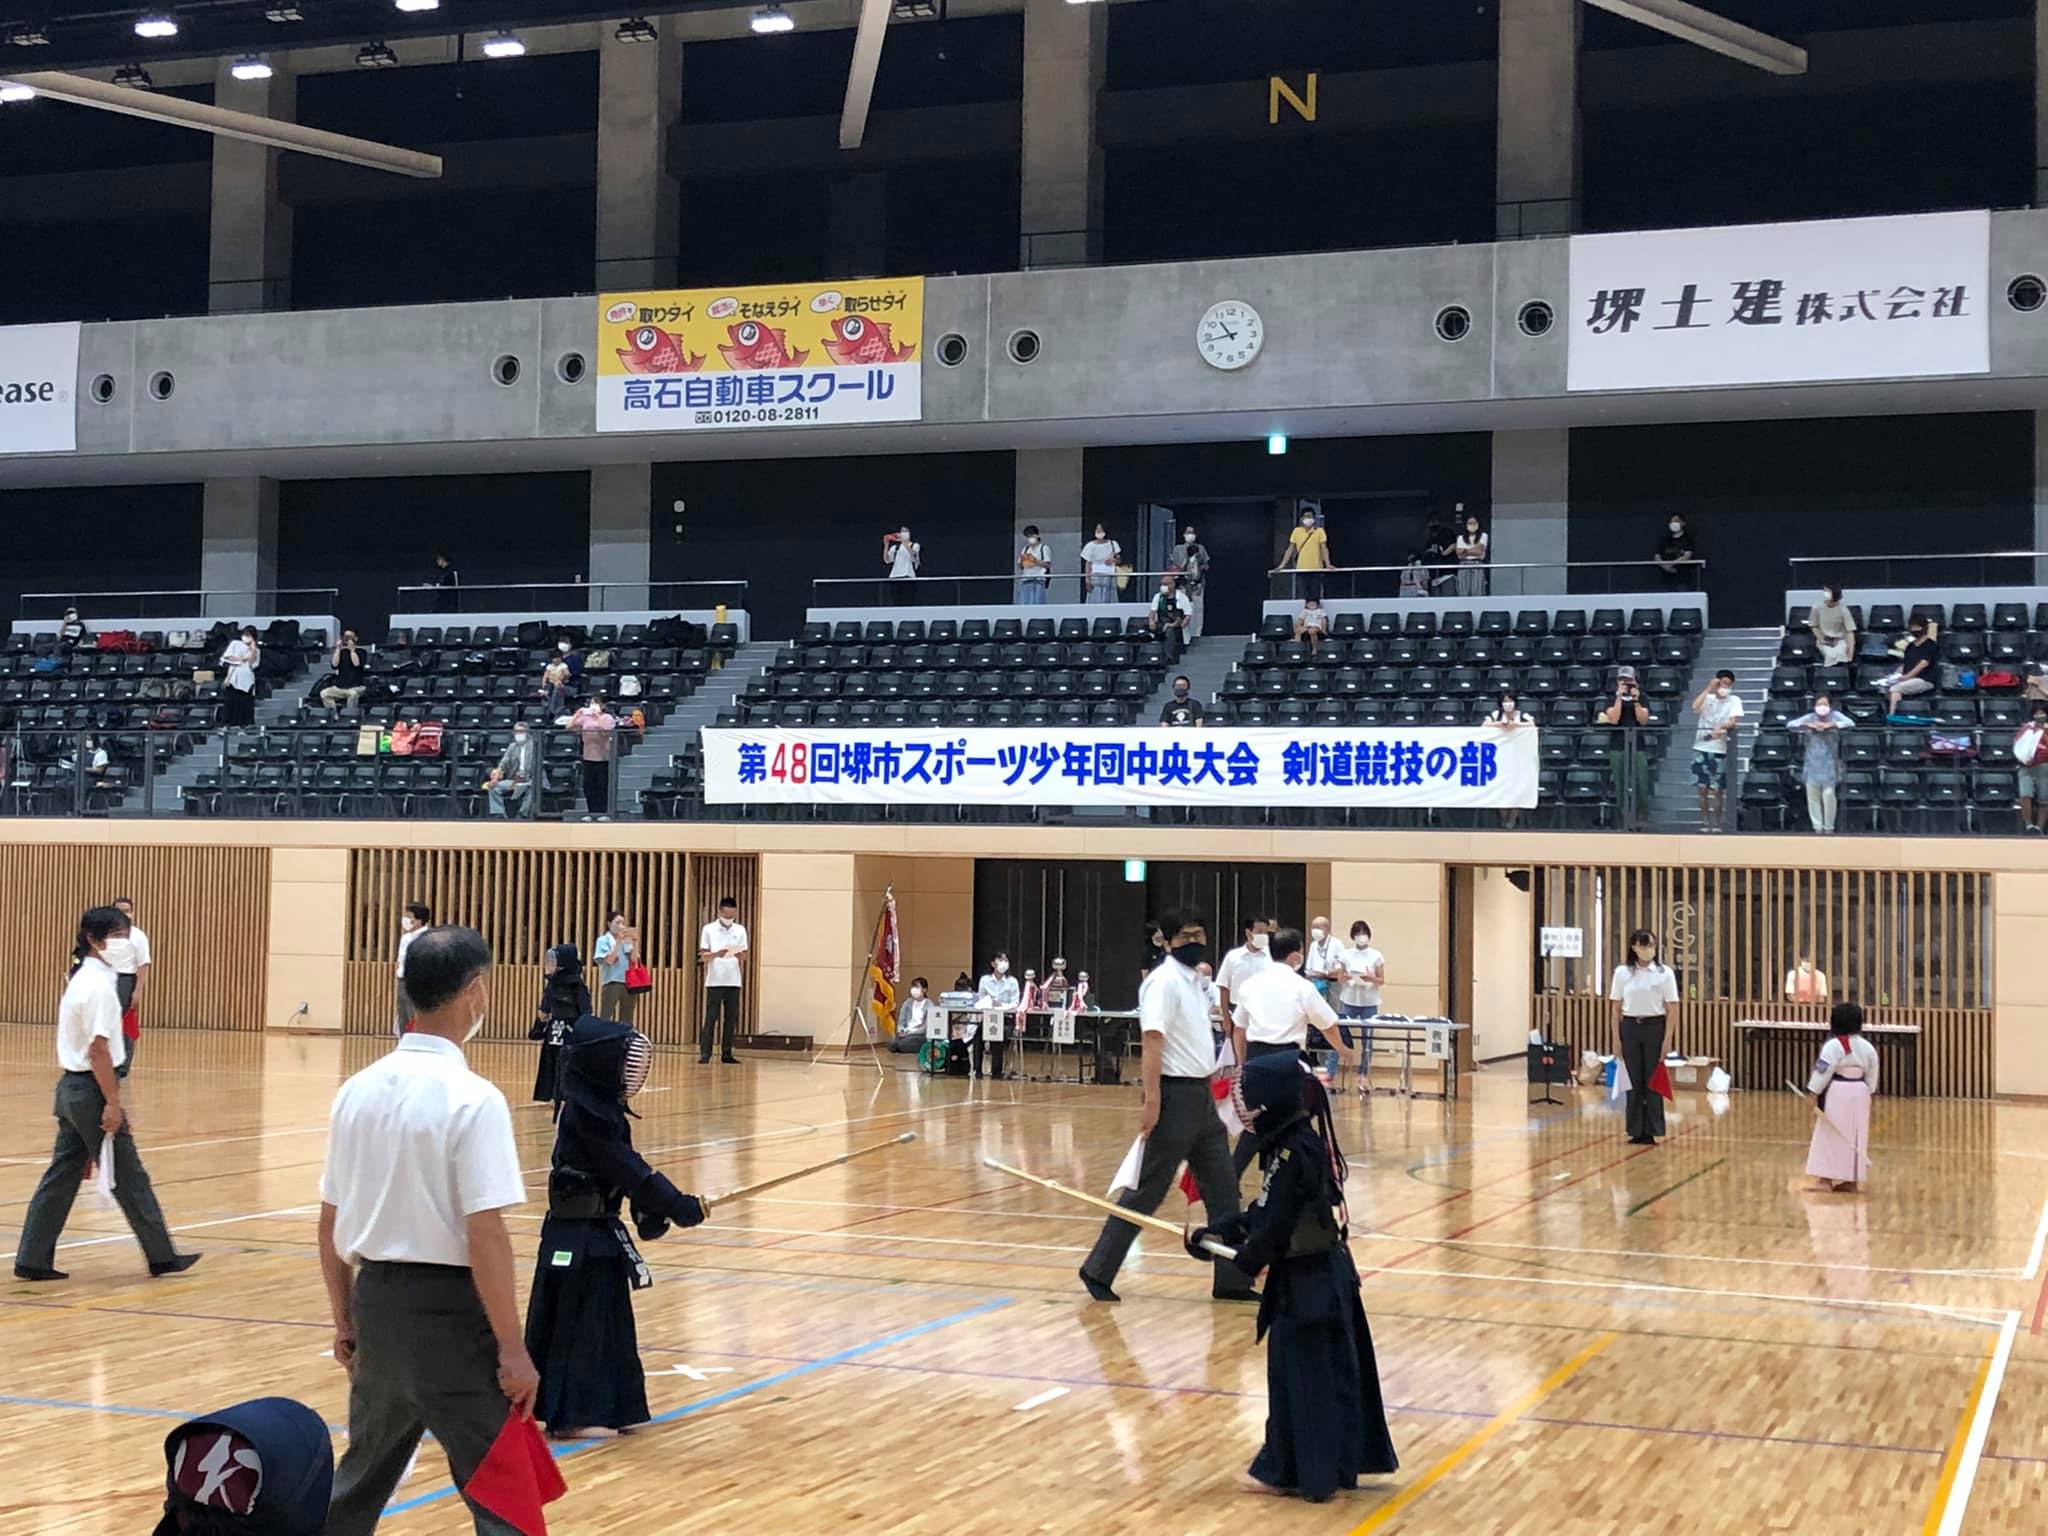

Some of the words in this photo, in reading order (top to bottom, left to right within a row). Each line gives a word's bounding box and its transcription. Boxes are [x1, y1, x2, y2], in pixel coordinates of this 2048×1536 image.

[1269, 73, 1317, 124] N
[740, 298, 802, 319] そなえタイ
[0, 381, 54, 403] ase
[623, 369, 895, 411] 高石自動車スクール
[713, 406, 819, 423] 0120-08-2811
[737, 738, 1260, 787] 第48回堺市スポーツ少年団中央大会
[1282, 740, 1499, 787] 剣道競技の部
